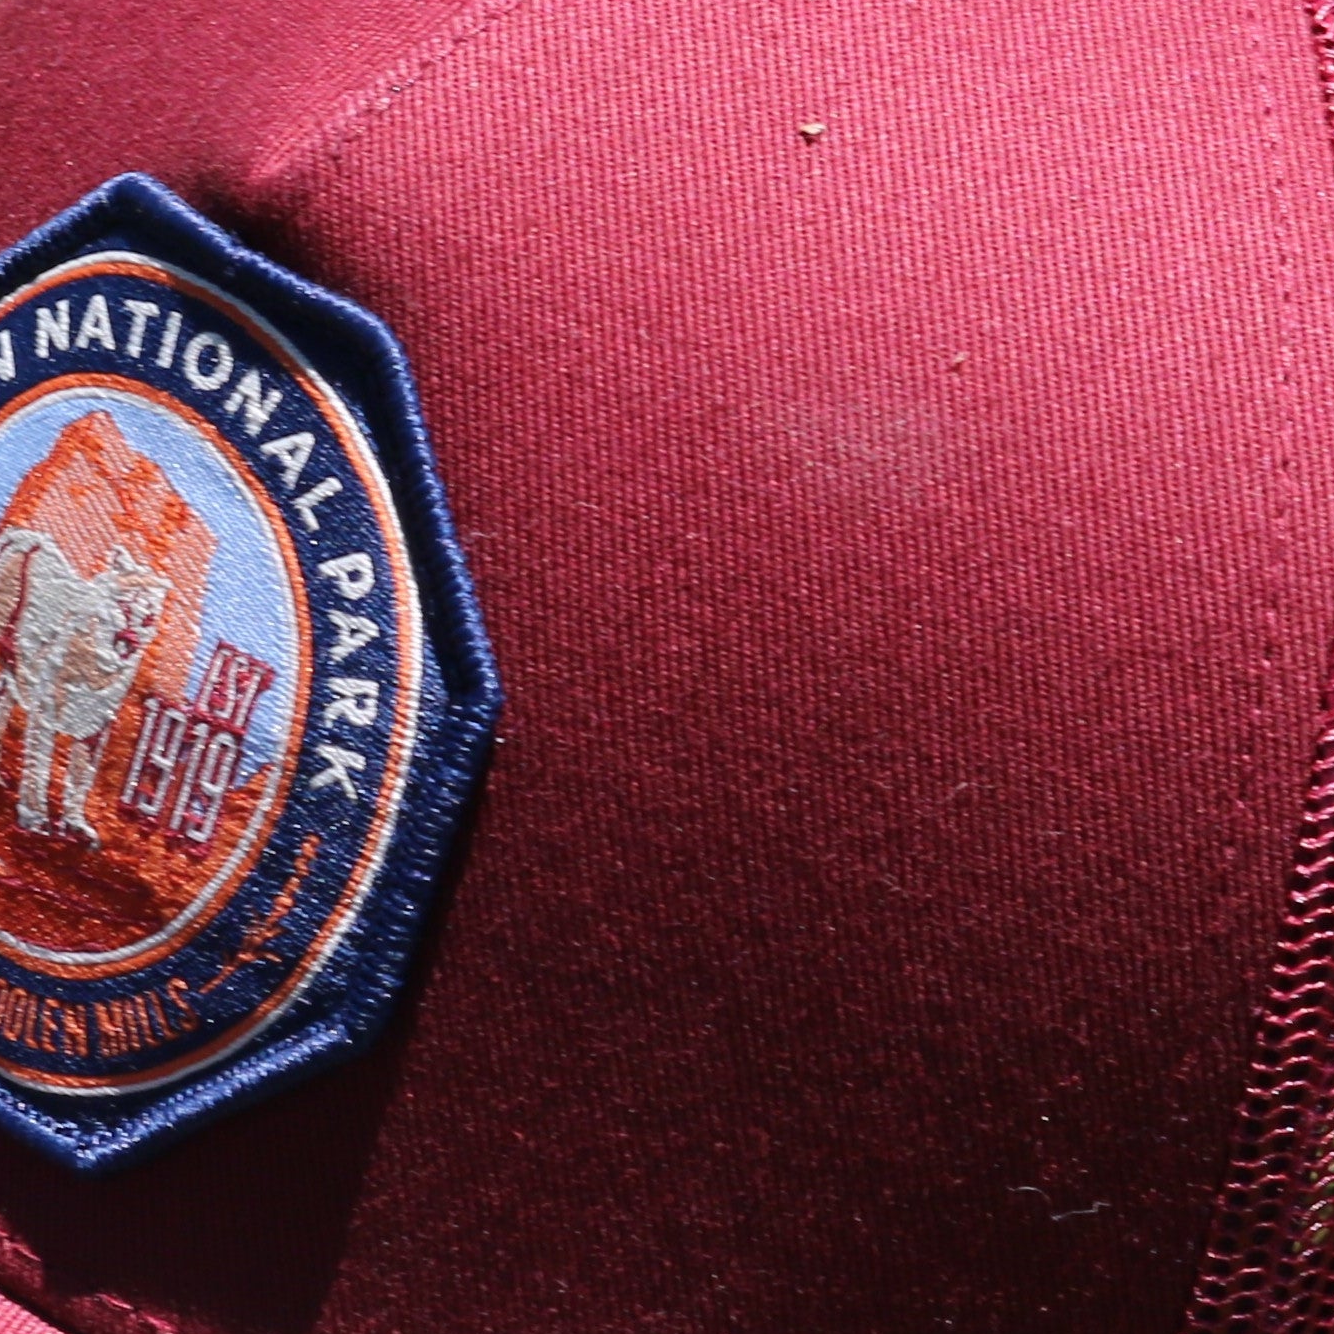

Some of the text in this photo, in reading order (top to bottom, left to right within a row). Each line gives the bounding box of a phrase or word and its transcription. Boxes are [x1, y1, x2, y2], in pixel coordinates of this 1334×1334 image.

[34, 293, 343, 532] NATIONAL
[308, 551, 381, 805] PARK
[119, 696, 240, 845] 1919
[93, 976, 199, 1057] MILLS
